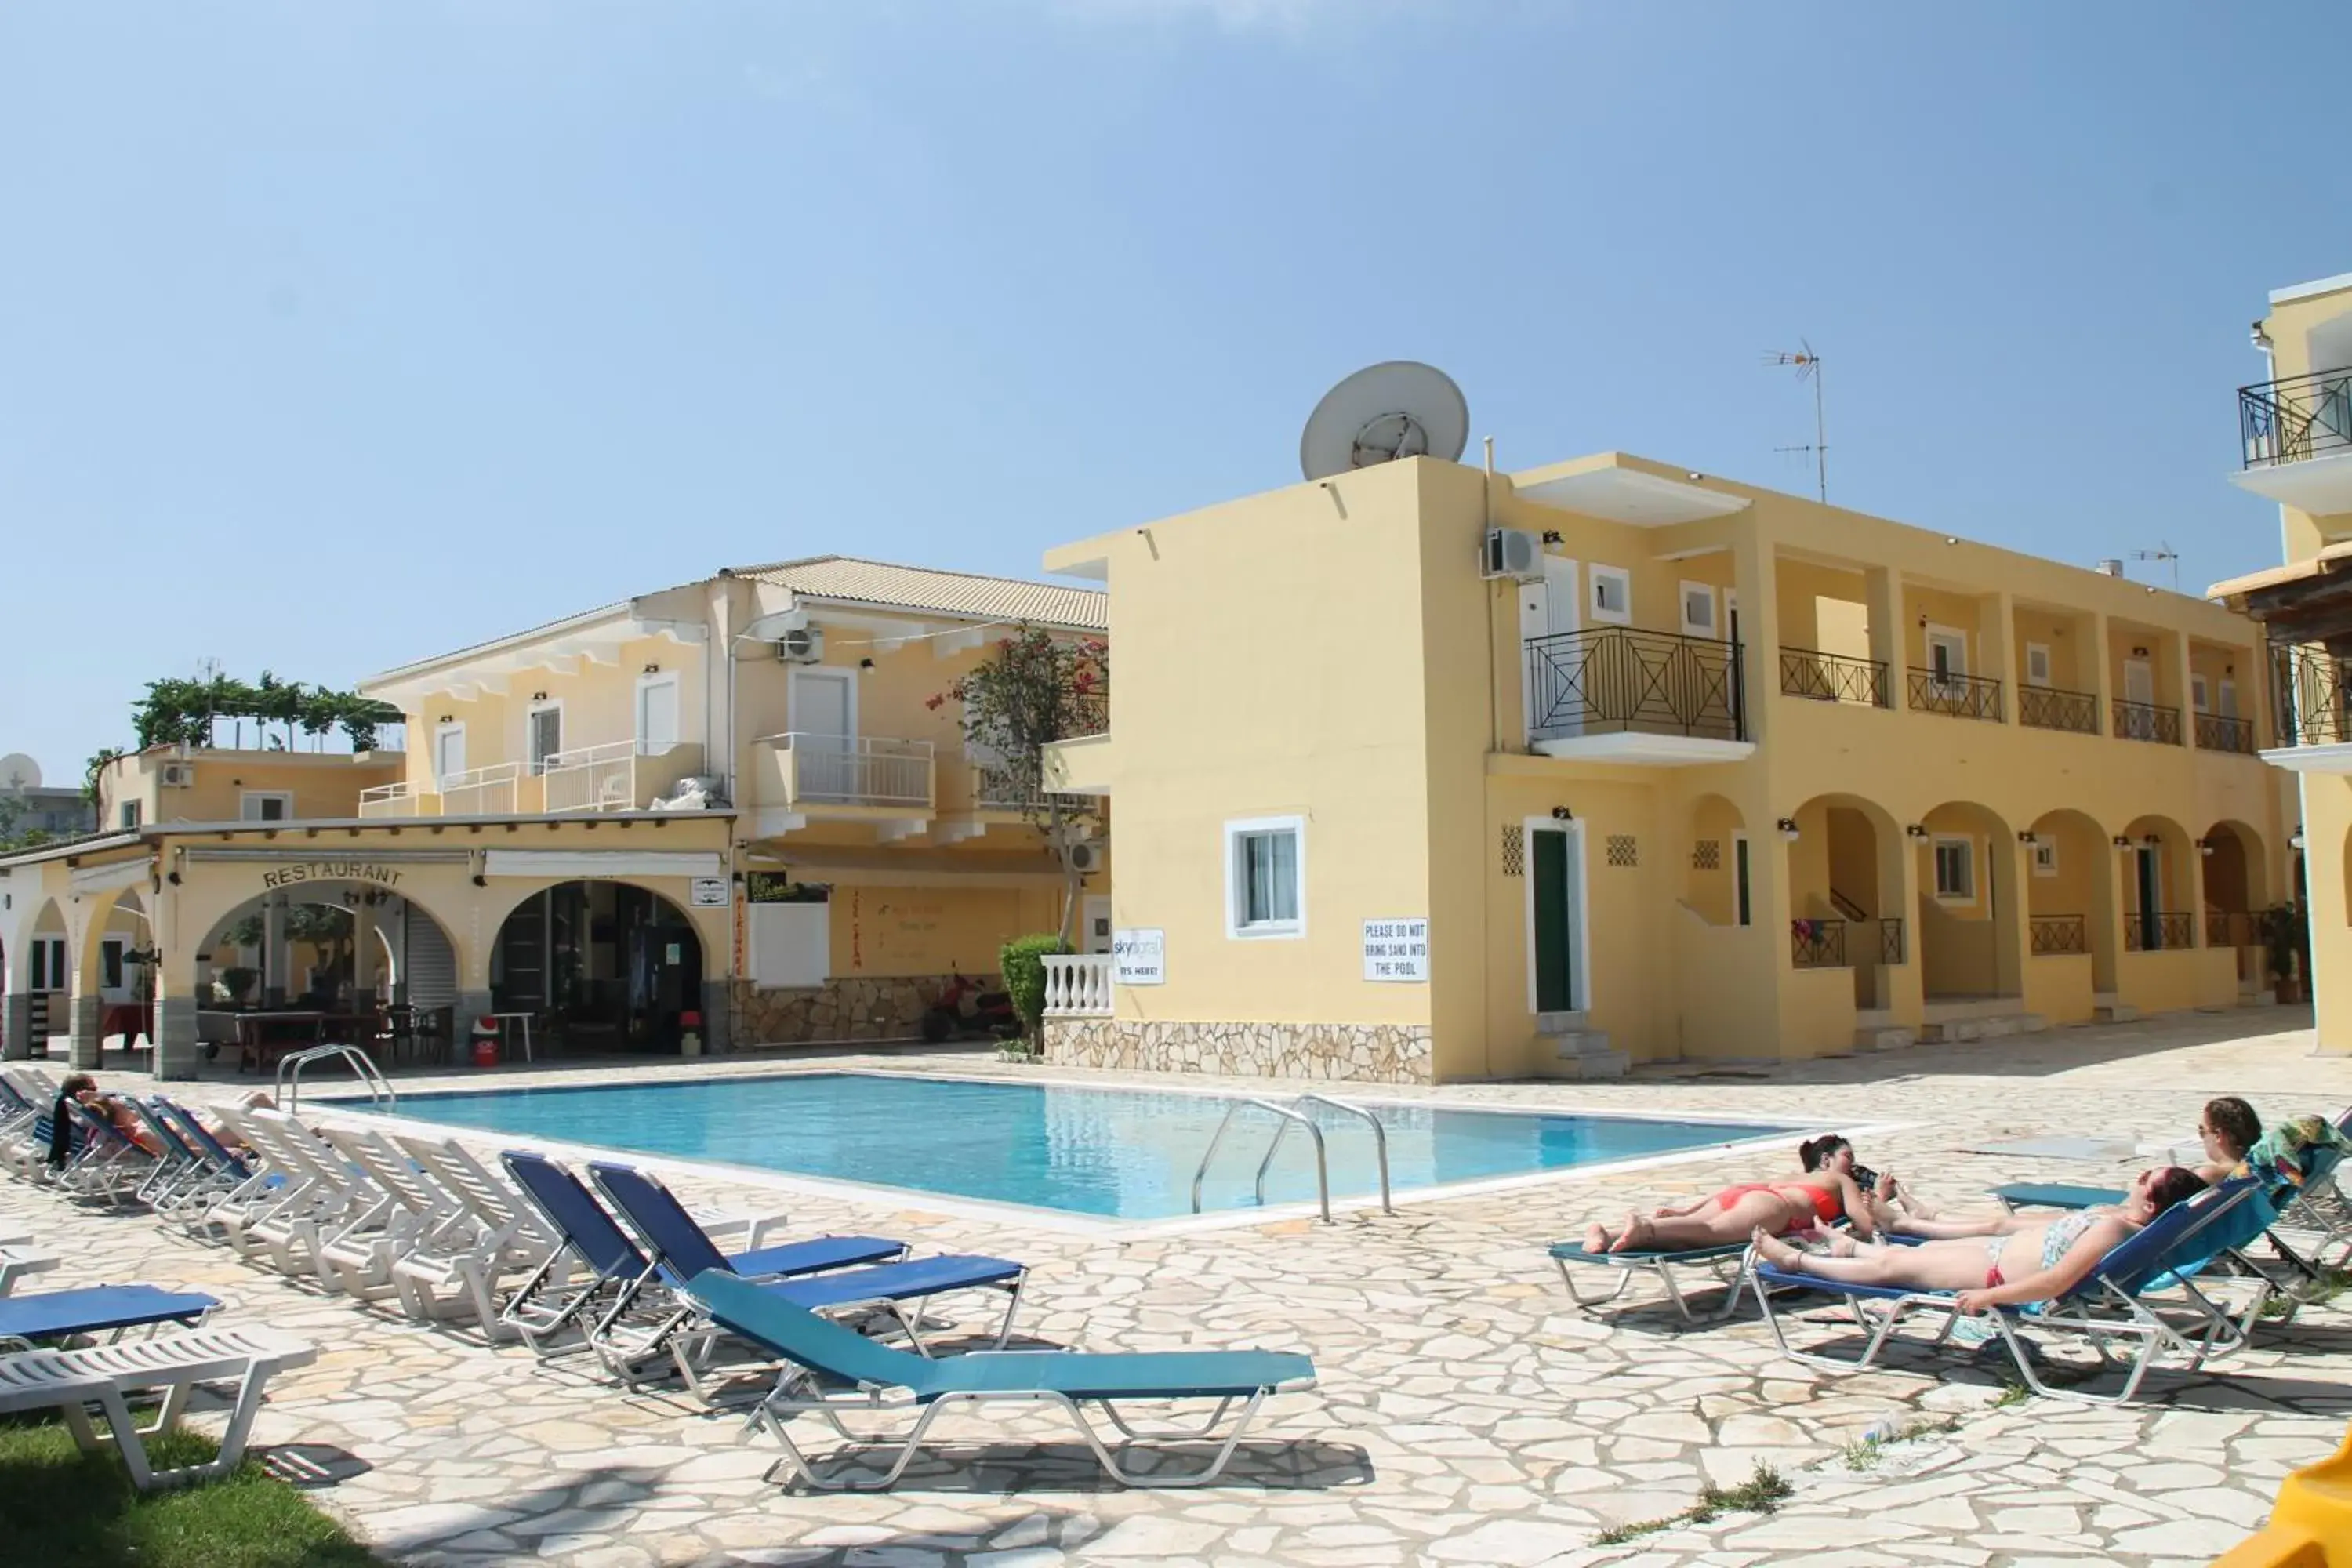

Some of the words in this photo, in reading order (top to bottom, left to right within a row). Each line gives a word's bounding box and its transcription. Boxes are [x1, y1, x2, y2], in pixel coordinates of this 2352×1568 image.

[263, 863, 404, 888] RESTAURANT
[1366, 924, 1393, 938] PLEASE
[1396, 924, 1406, 937] DO
[1410, 924, 1425, 937] NOT
[1366, 944, 1386, 956] BRING
[1388, 943, 1406, 956] SAND
[1410, 944, 1425, 956] INTO
[1375, 962, 1391, 975] THE
[1395, 962, 1416, 975] POOL
